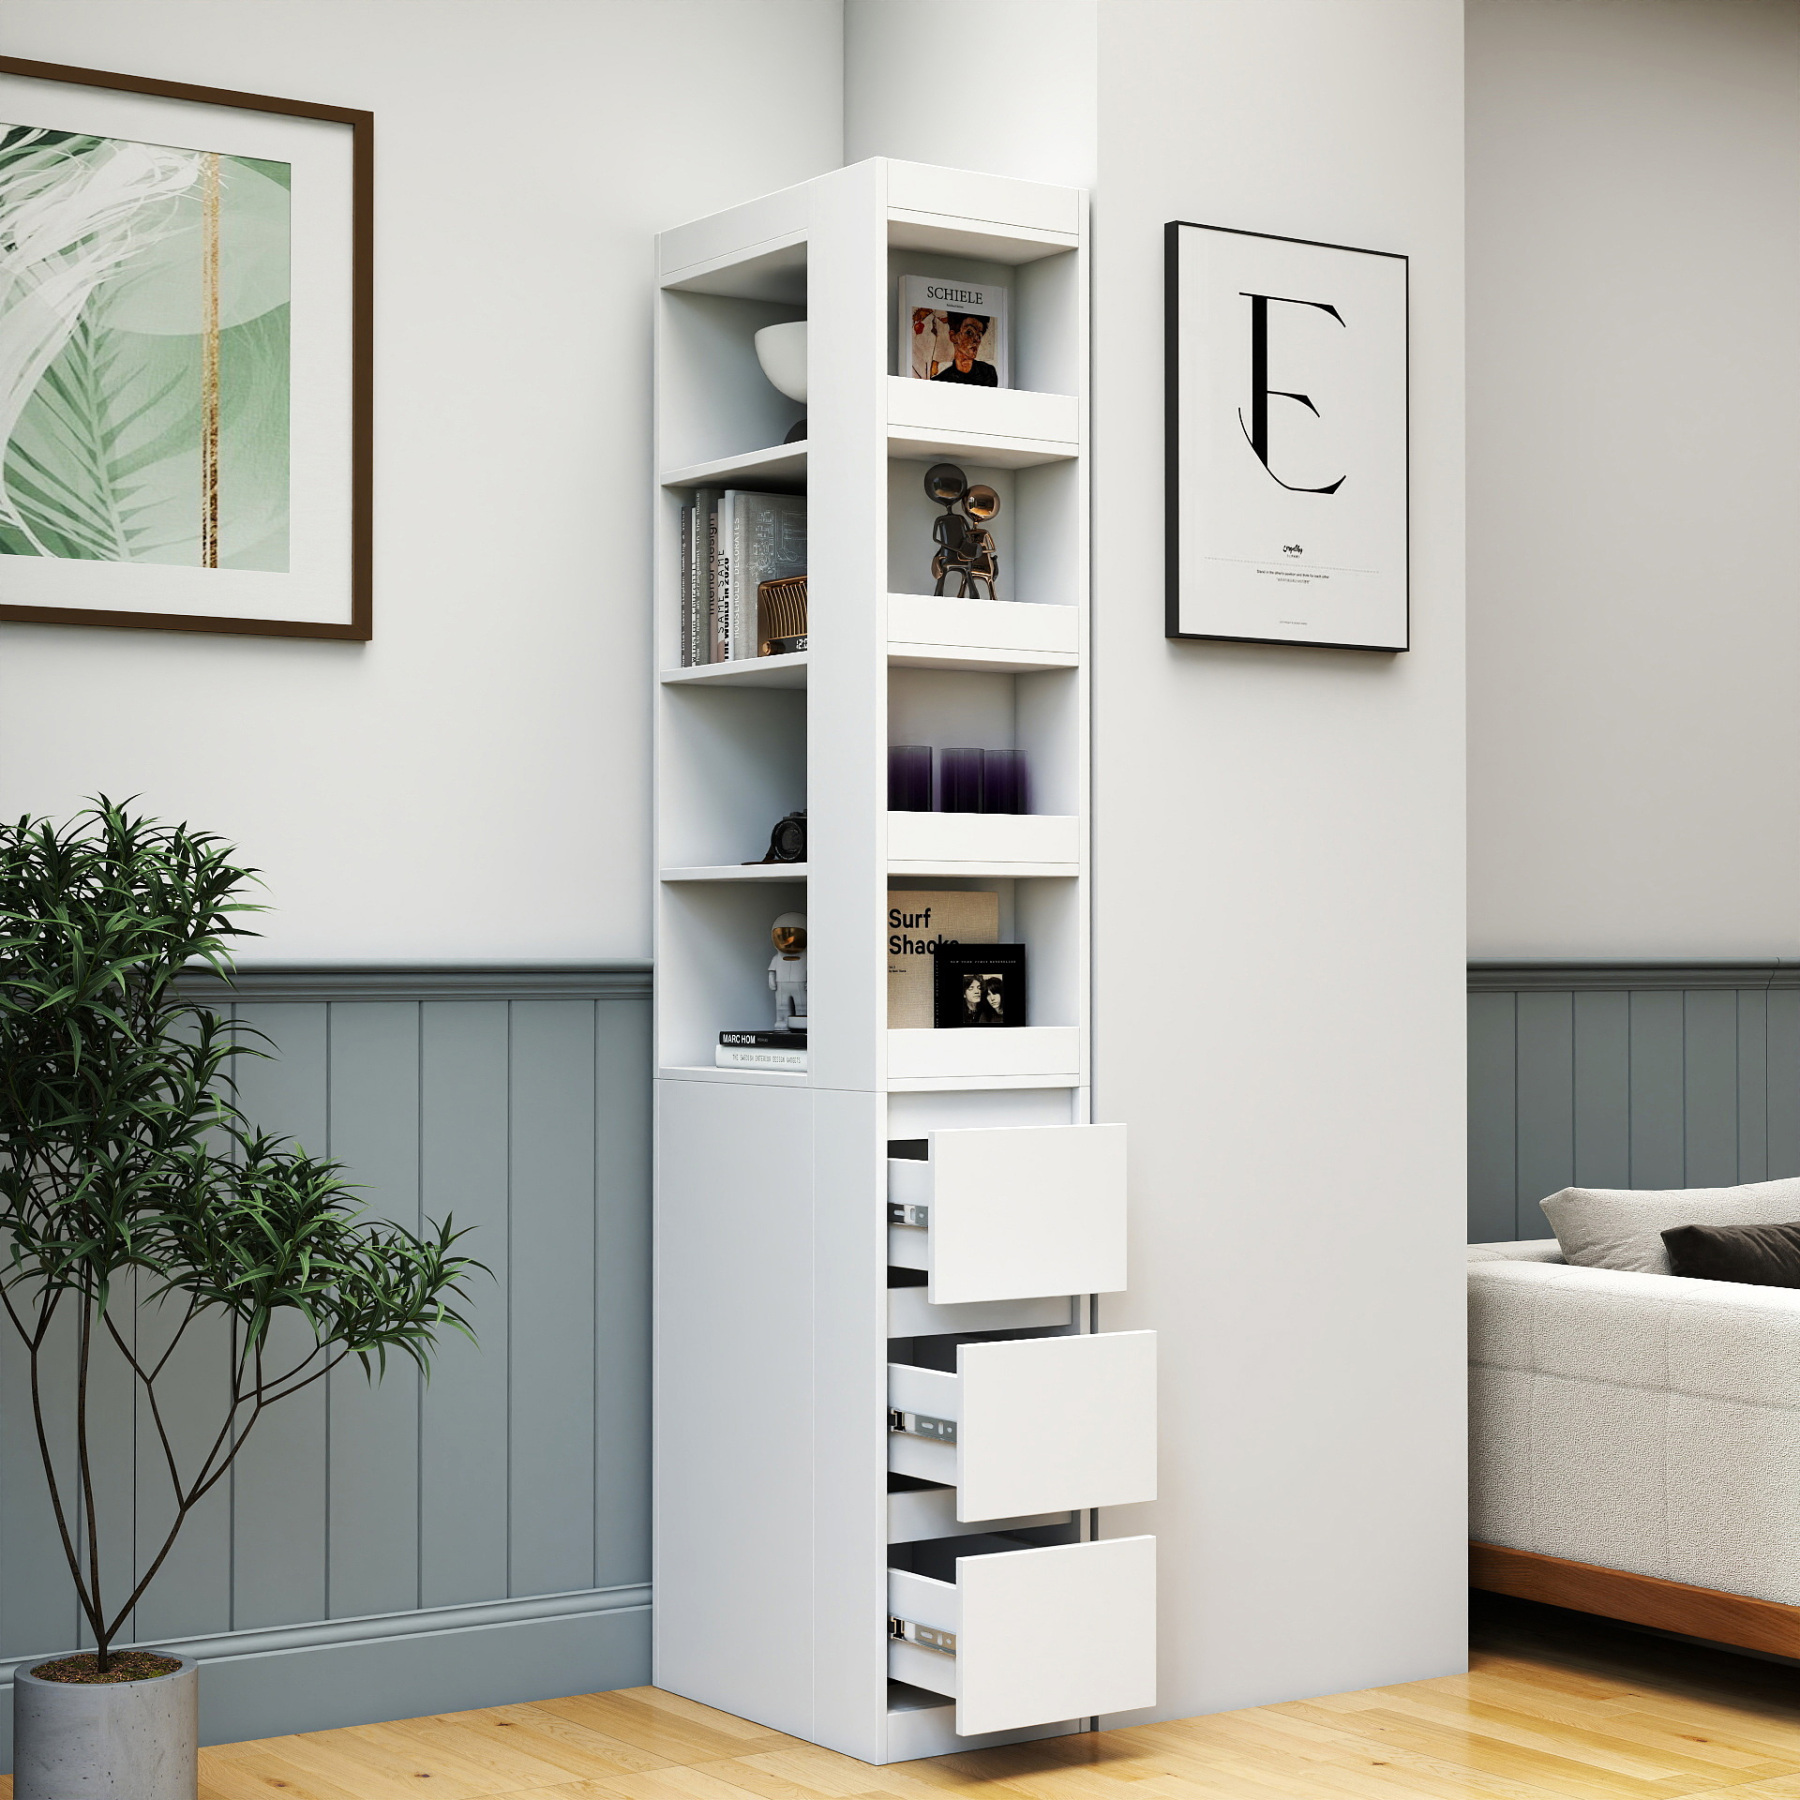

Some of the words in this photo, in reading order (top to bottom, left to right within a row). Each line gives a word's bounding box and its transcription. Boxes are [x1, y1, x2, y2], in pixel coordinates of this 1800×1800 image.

[927, 286, 983, 305] SCHIELE
[1238, 292, 1346, 494] E
[717, 549, 725, 588] SAME
[717, 596, 725, 634] SAME
[889, 907, 932, 928] Surf
[889, 934, 959, 955] Shac
[722, 1034, 740, 1044] MARC
[741, 1034, 756, 1044] HOM
